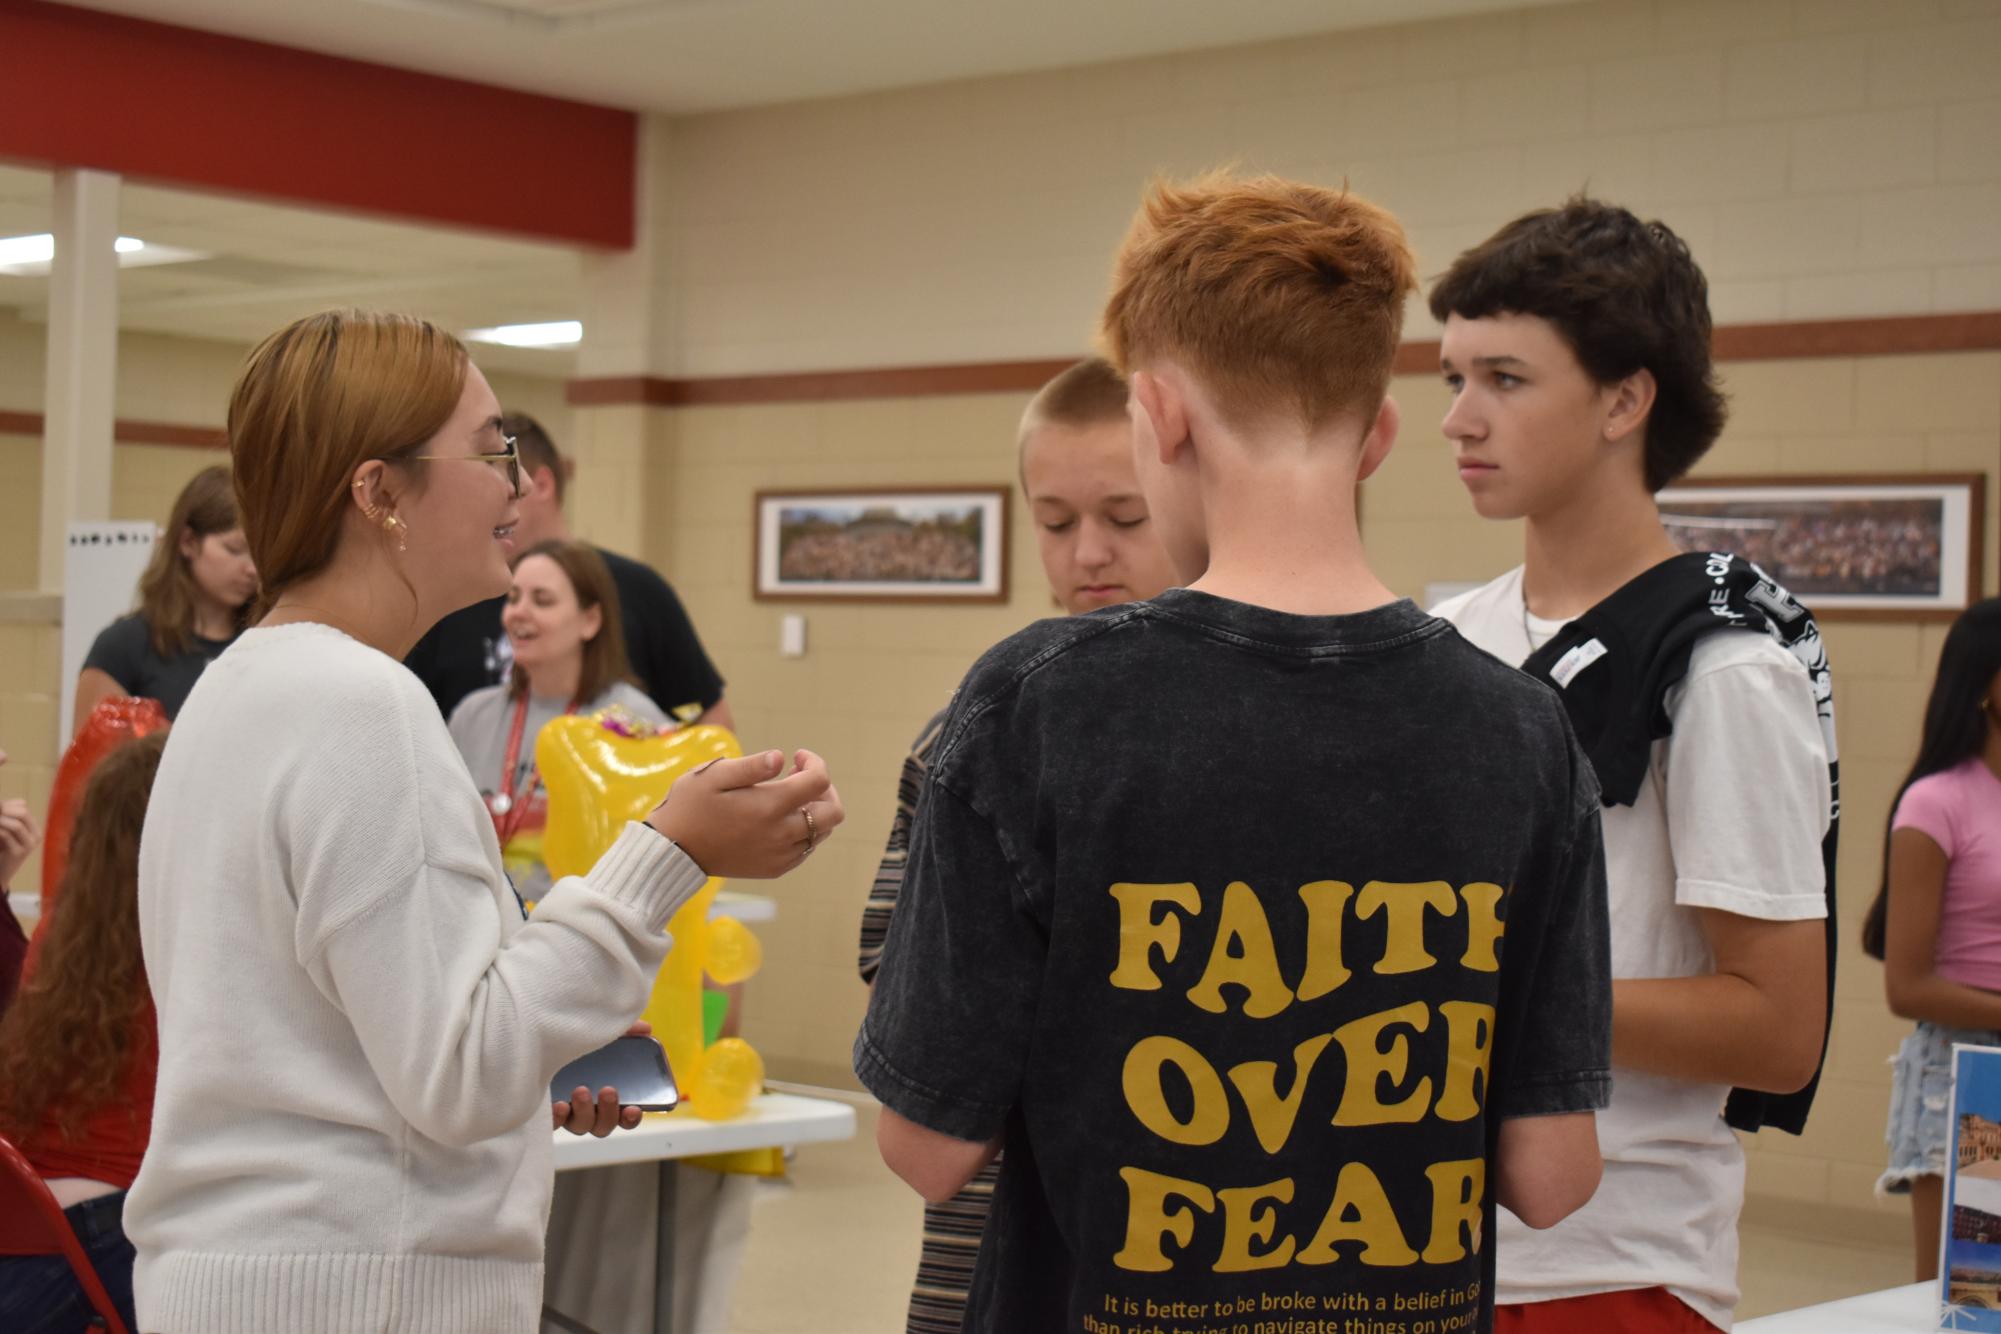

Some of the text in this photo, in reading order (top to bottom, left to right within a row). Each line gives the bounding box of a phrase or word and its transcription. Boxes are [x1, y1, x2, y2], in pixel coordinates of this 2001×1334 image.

[1121, 1000, 1497, 1155] OVER
[1112, 1157, 1486, 1273] FEAR
[1104, 1279, 1480, 1319] It is better to be broke with a belief in Go
